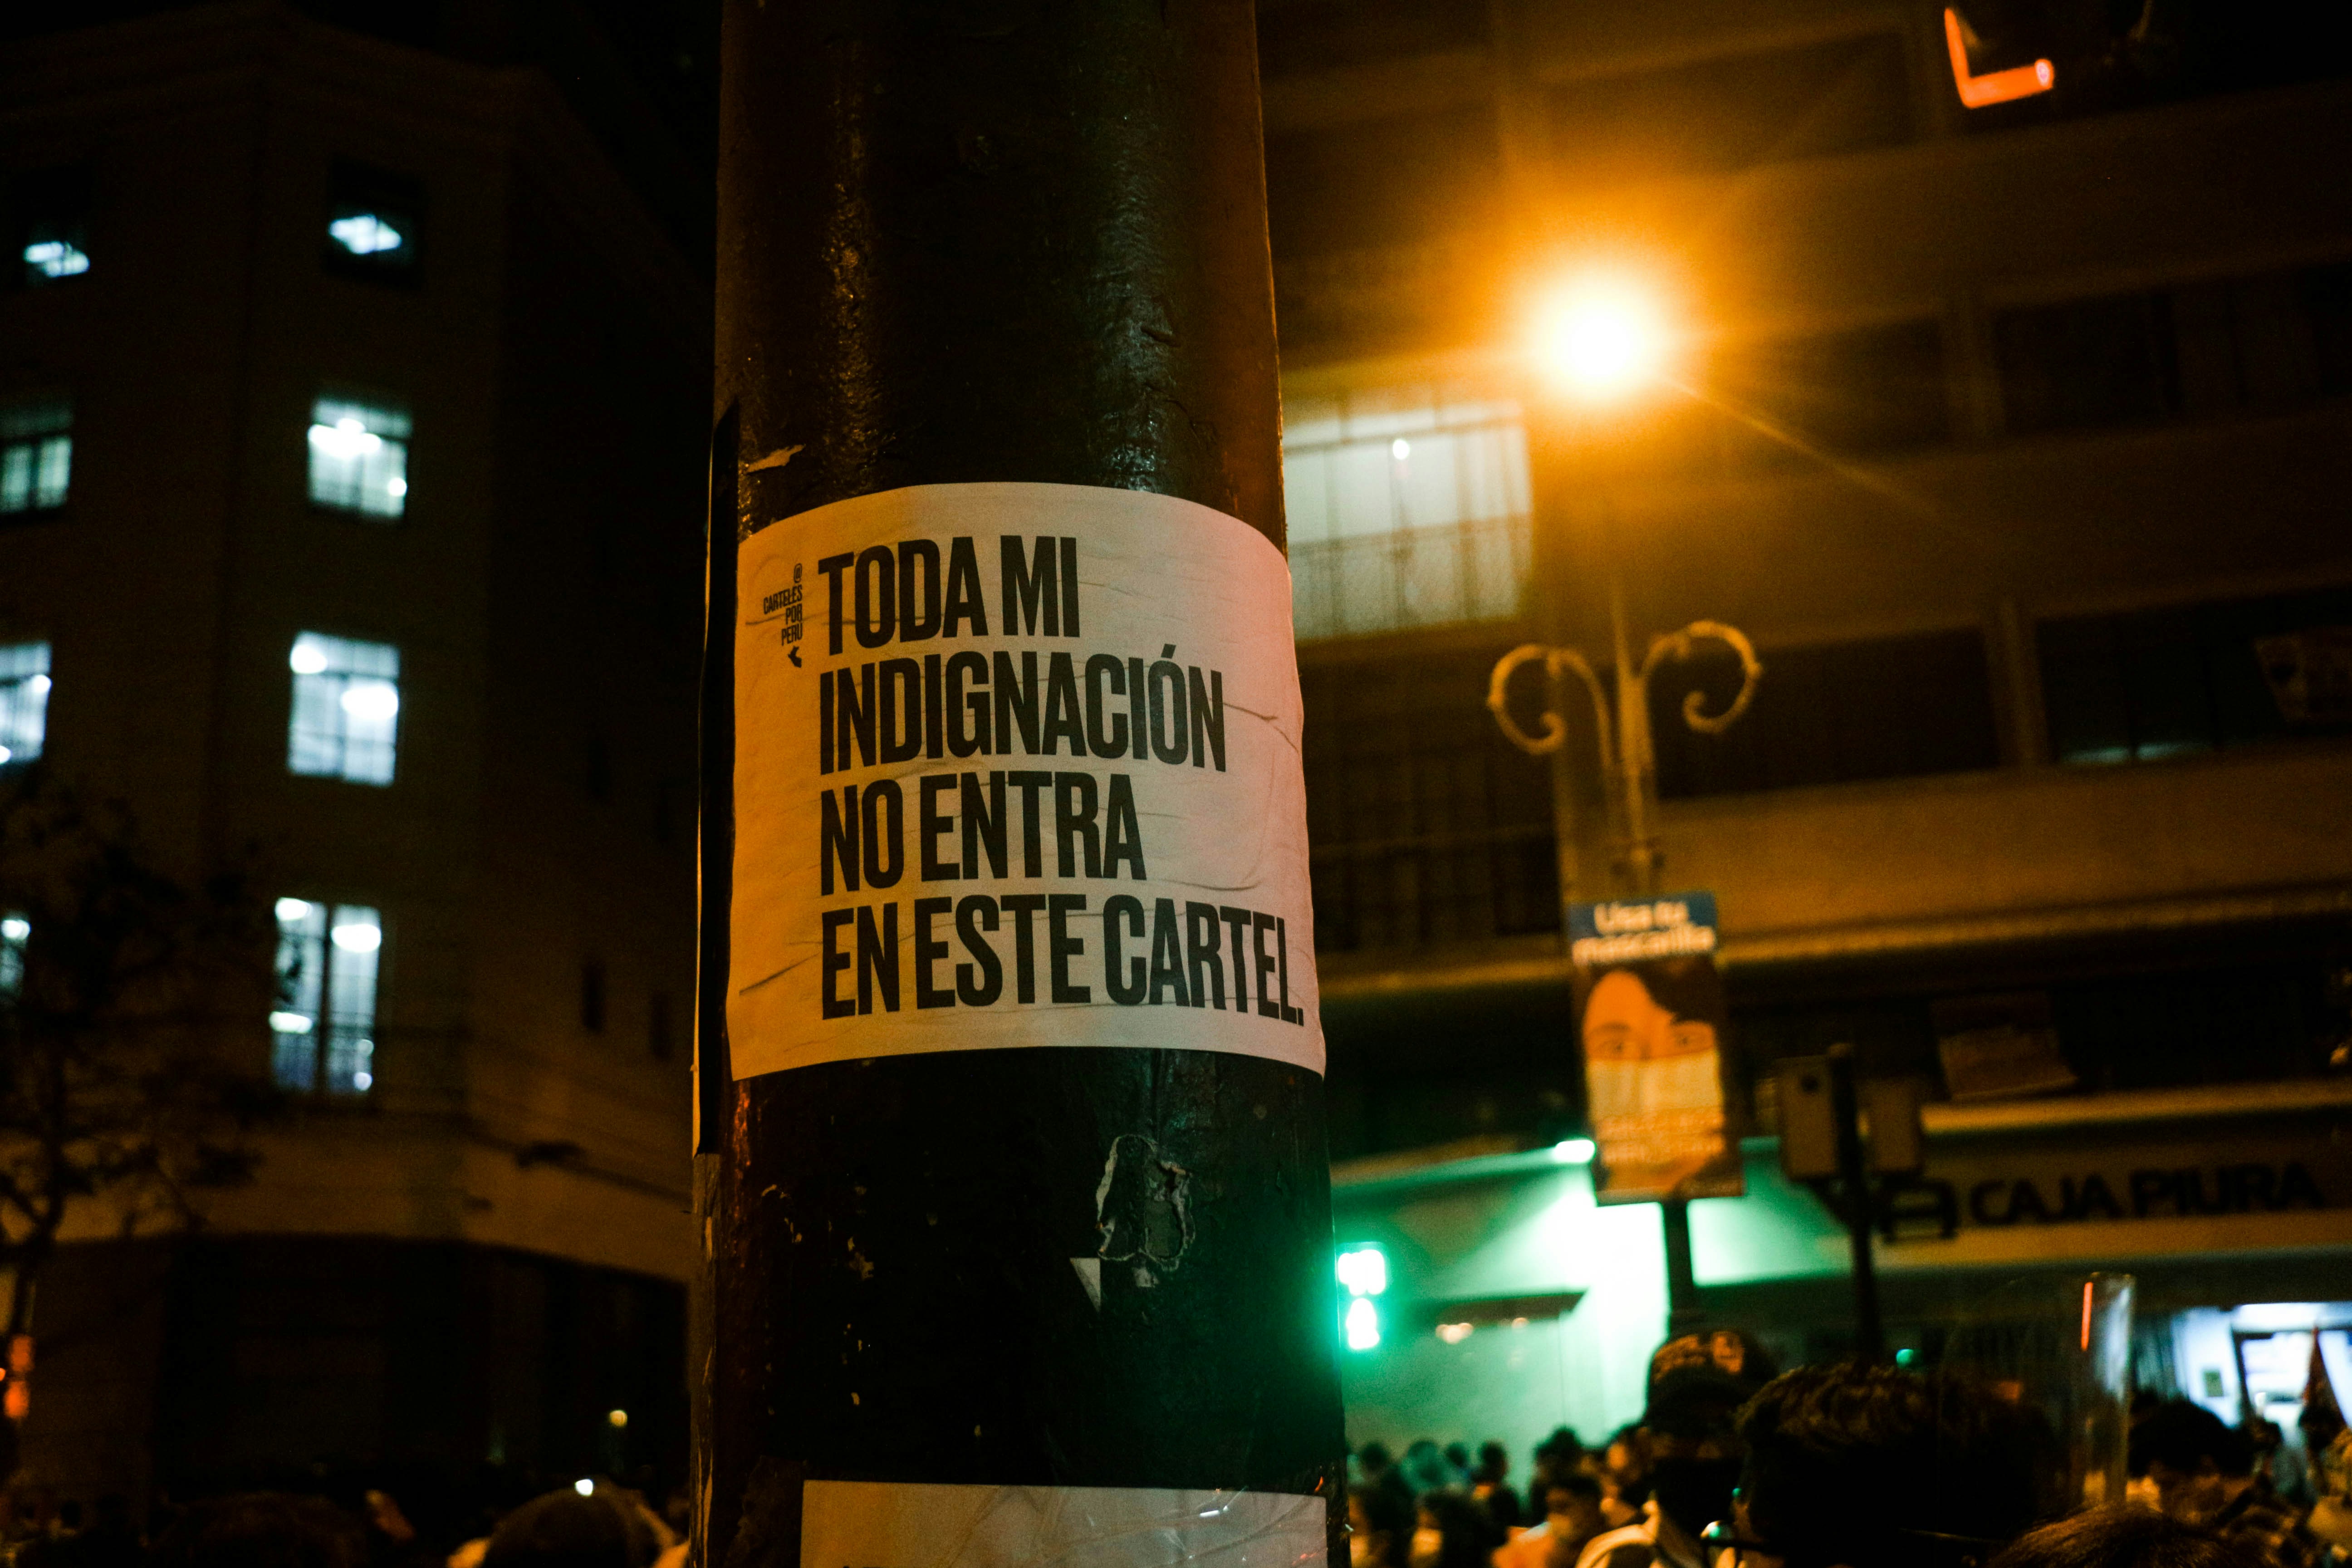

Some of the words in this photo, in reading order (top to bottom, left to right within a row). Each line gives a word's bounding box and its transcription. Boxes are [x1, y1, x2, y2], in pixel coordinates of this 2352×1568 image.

[764, 584, 803, 614] CARTELES
[818, 537, 988, 656] TODA
[1000, 535, 1080, 637] MI
[820, 643, 1226, 775] INDIGNACIÓN
[821, 779, 904, 897] NO
[921, 771, 1147, 882] ENTRA
[822, 902, 900, 1020] EN
[915, 895, 1091, 1009] ESTE
[1103, 895, 1304, 1027] CARTEL.
[1970, 1174, 2122, 1226] CAJA
[2128, 1162, 2325, 1218] PIURA
